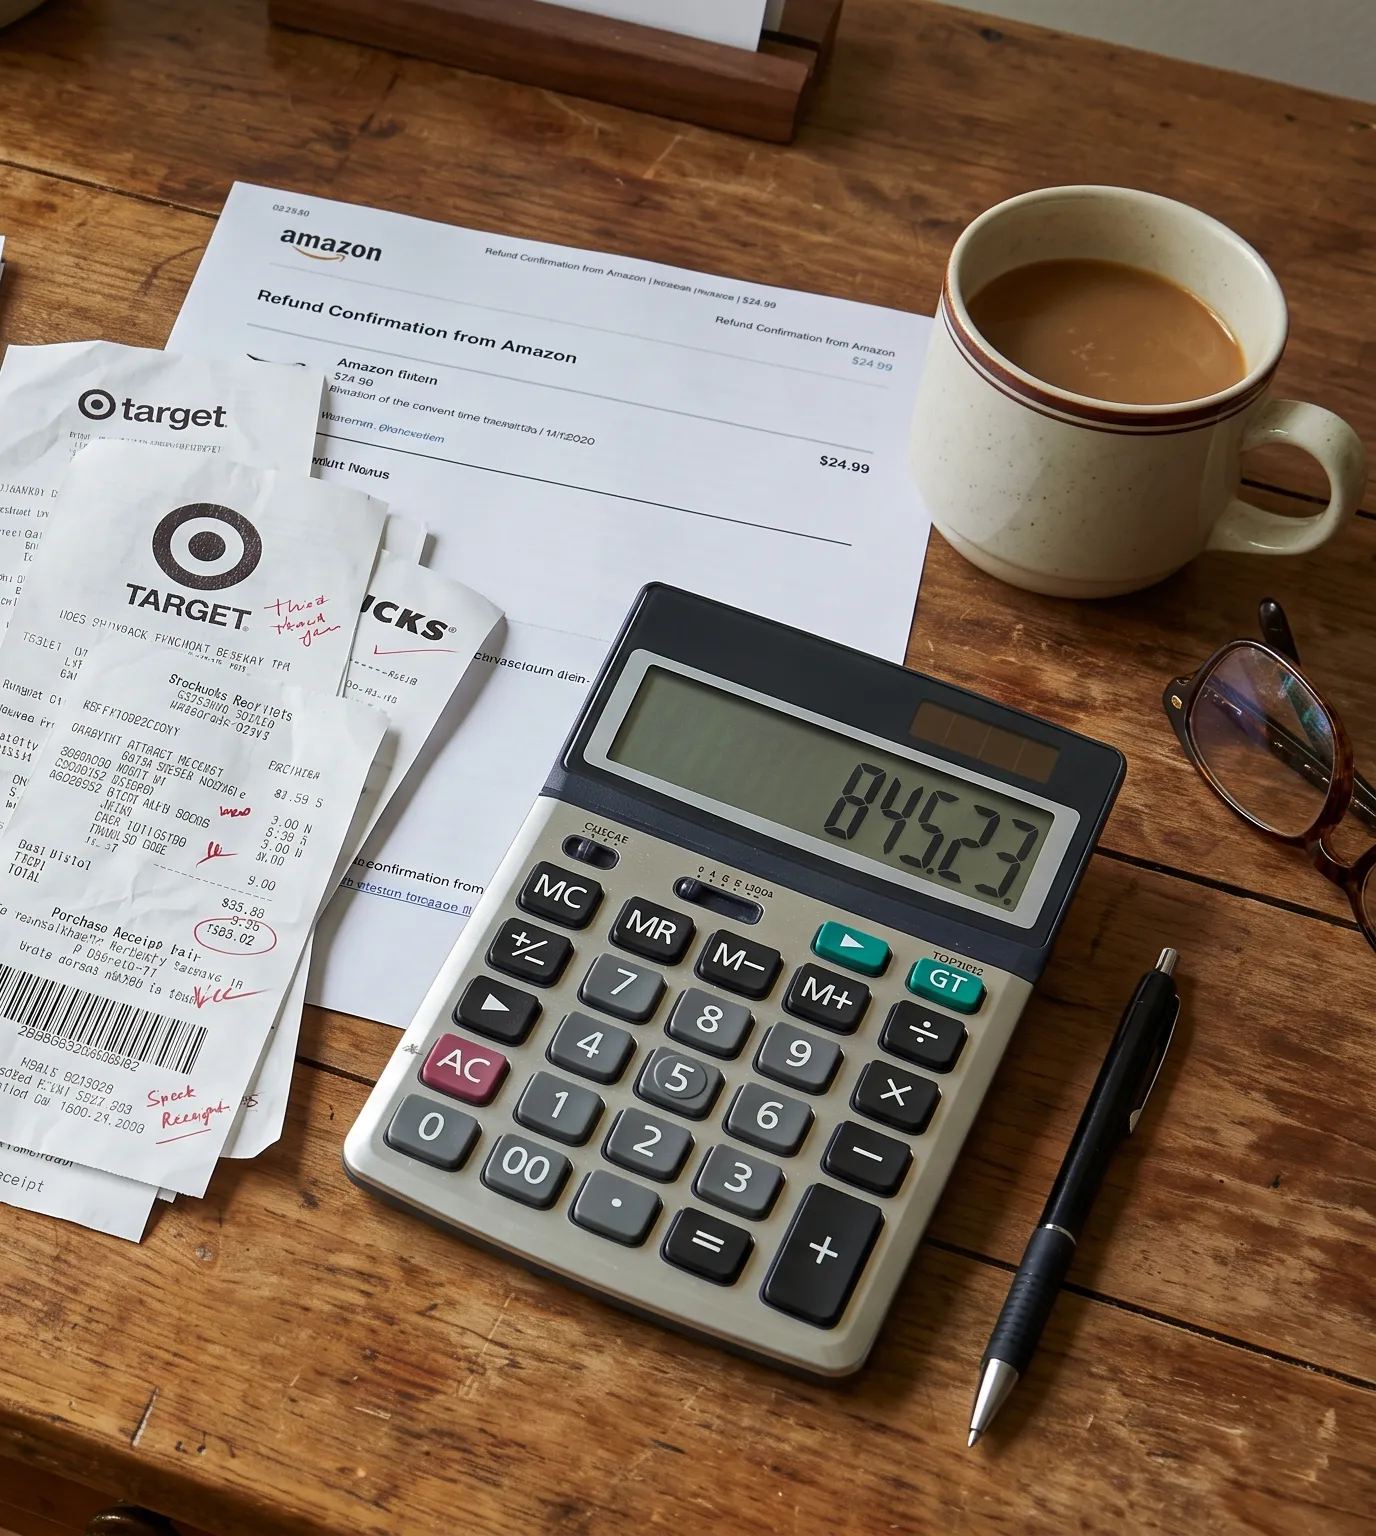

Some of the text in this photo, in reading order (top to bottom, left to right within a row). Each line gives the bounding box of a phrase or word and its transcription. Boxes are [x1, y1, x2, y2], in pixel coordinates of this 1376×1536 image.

[280, 228, 383, 262] amazon
[485, 247, 518, 260] Refund
[520, 253, 580, 270] Confirmation
[582, 264, 604, 275] from
[606, 269, 646, 283] Amazon
[257, 288, 579, 365] Refund Confirmation from Amazon
[715, 315, 896, 358] Refund Confirmation from Amazon
[337, 358, 394, 377] Amazon
[392, 398, 410, 408] the
[819, 454, 871, 475] $24.99
[8, 862, 40, 884] TOTAL
[247, 874, 277, 892] 9.00
[452, 878, 486, 896] from
[534, 872, 588, 909] MC
[626, 908, 677, 945] MR
[615, 968, 640, 996] 7
[801, 976, 854, 1011] M+
[929, 968, 968, 993] GT
[695, 1004, 724, 1034] 8
[576, 1030, 603, 1060] 4
[786, 1039, 813, 1068] 9
[436, 1046, 491, 1084] AC
[663, 1062, 690, 1092] 5
[551, 1090, 569, 1119] 1
[756, 1100, 781, 1131] 6
[418, 1111, 446, 1142] 0
[632, 1124, 663, 1156] 2
[501, 1145, 551, 1186] 00
[724, 1162, 754, 1193] 3
